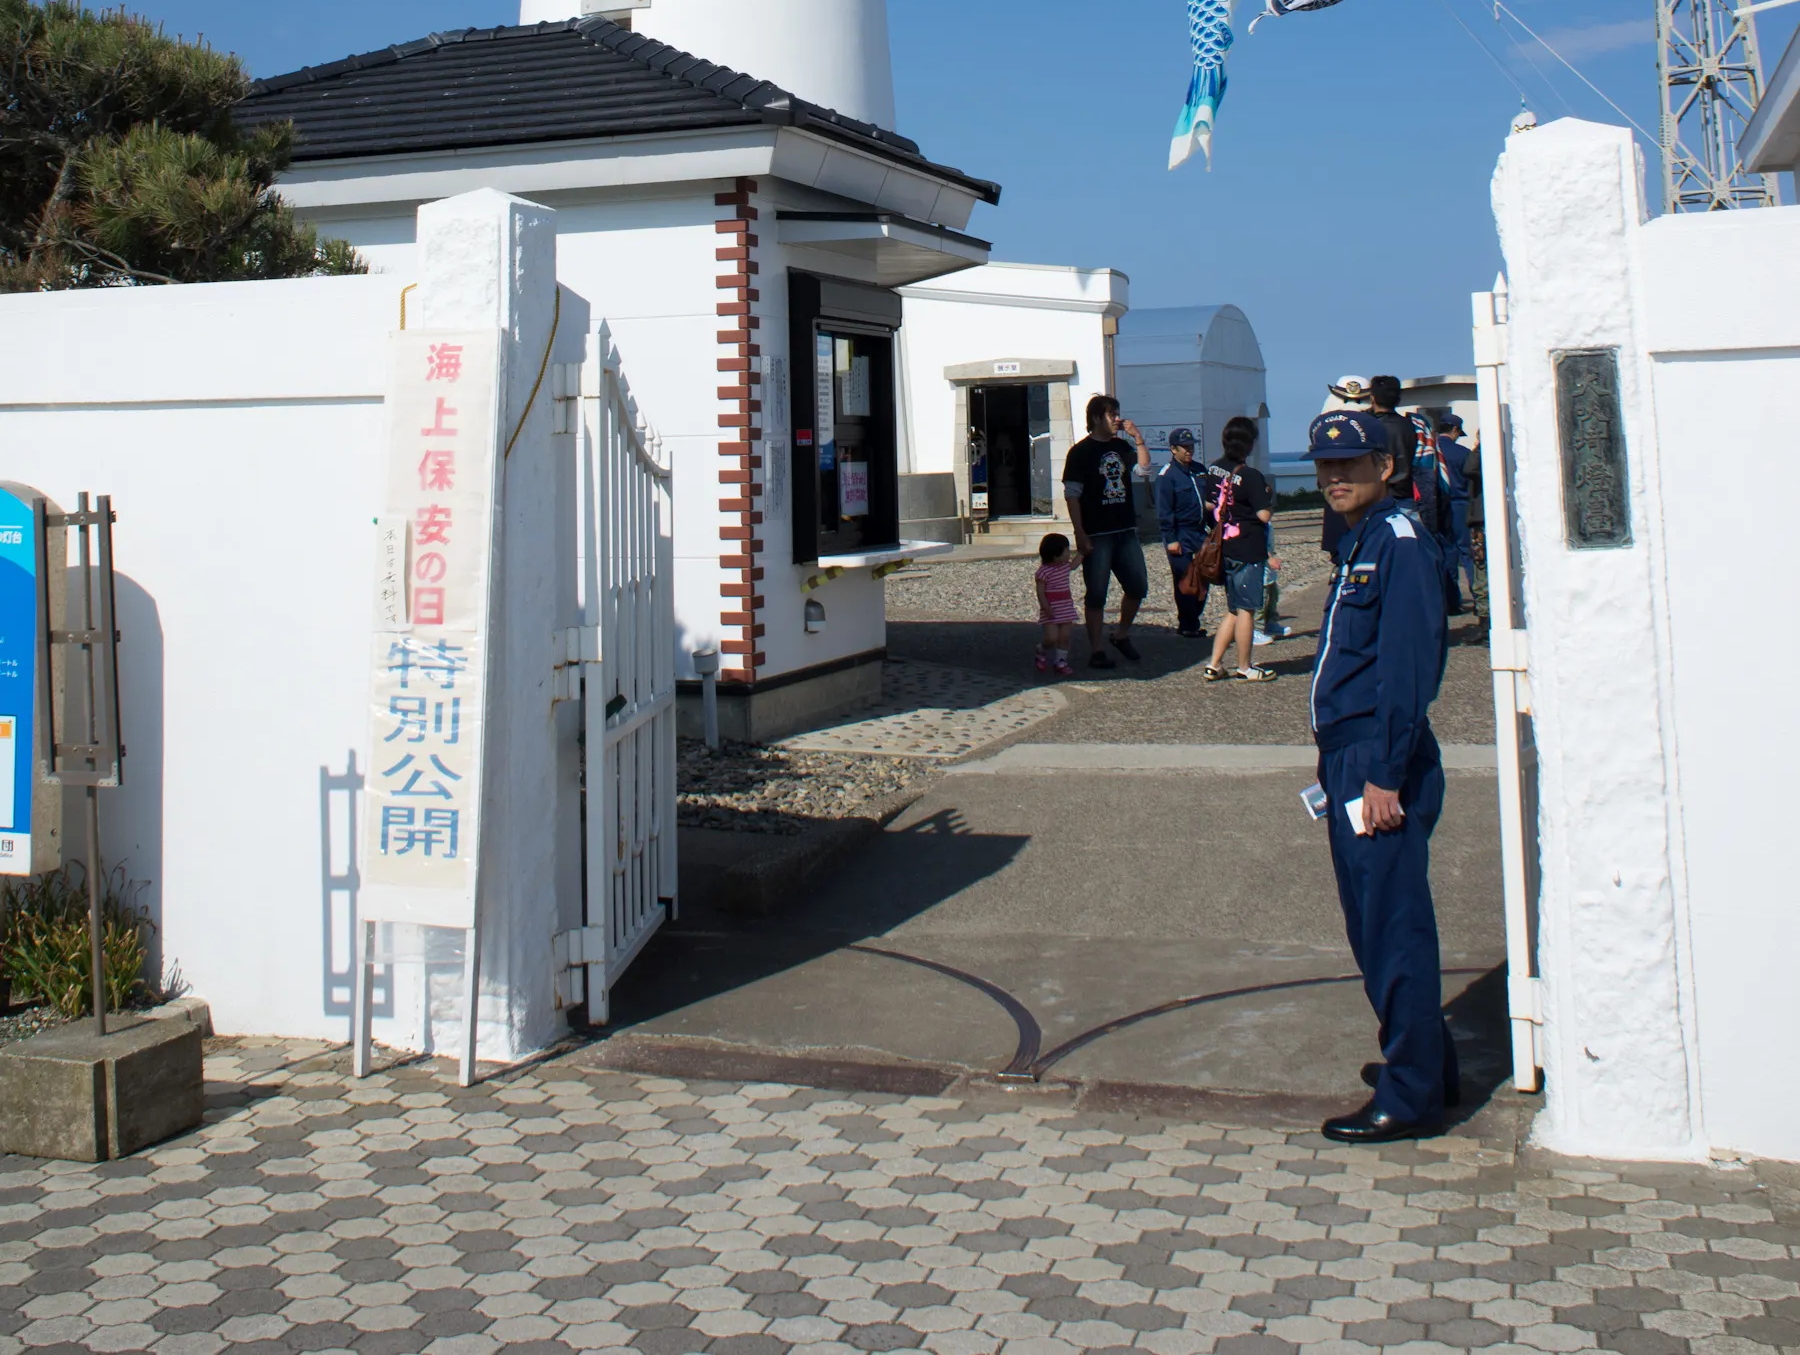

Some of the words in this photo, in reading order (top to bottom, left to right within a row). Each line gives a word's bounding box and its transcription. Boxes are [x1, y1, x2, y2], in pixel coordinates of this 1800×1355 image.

[412, 342, 464, 625] 海上保安の日
[1324, 414, 1349, 423] COAST
[1349, 419, 1367, 443] GUARD
[0, 531, 23, 544] 灯台
[380, 637, 468, 859] 特別公開
